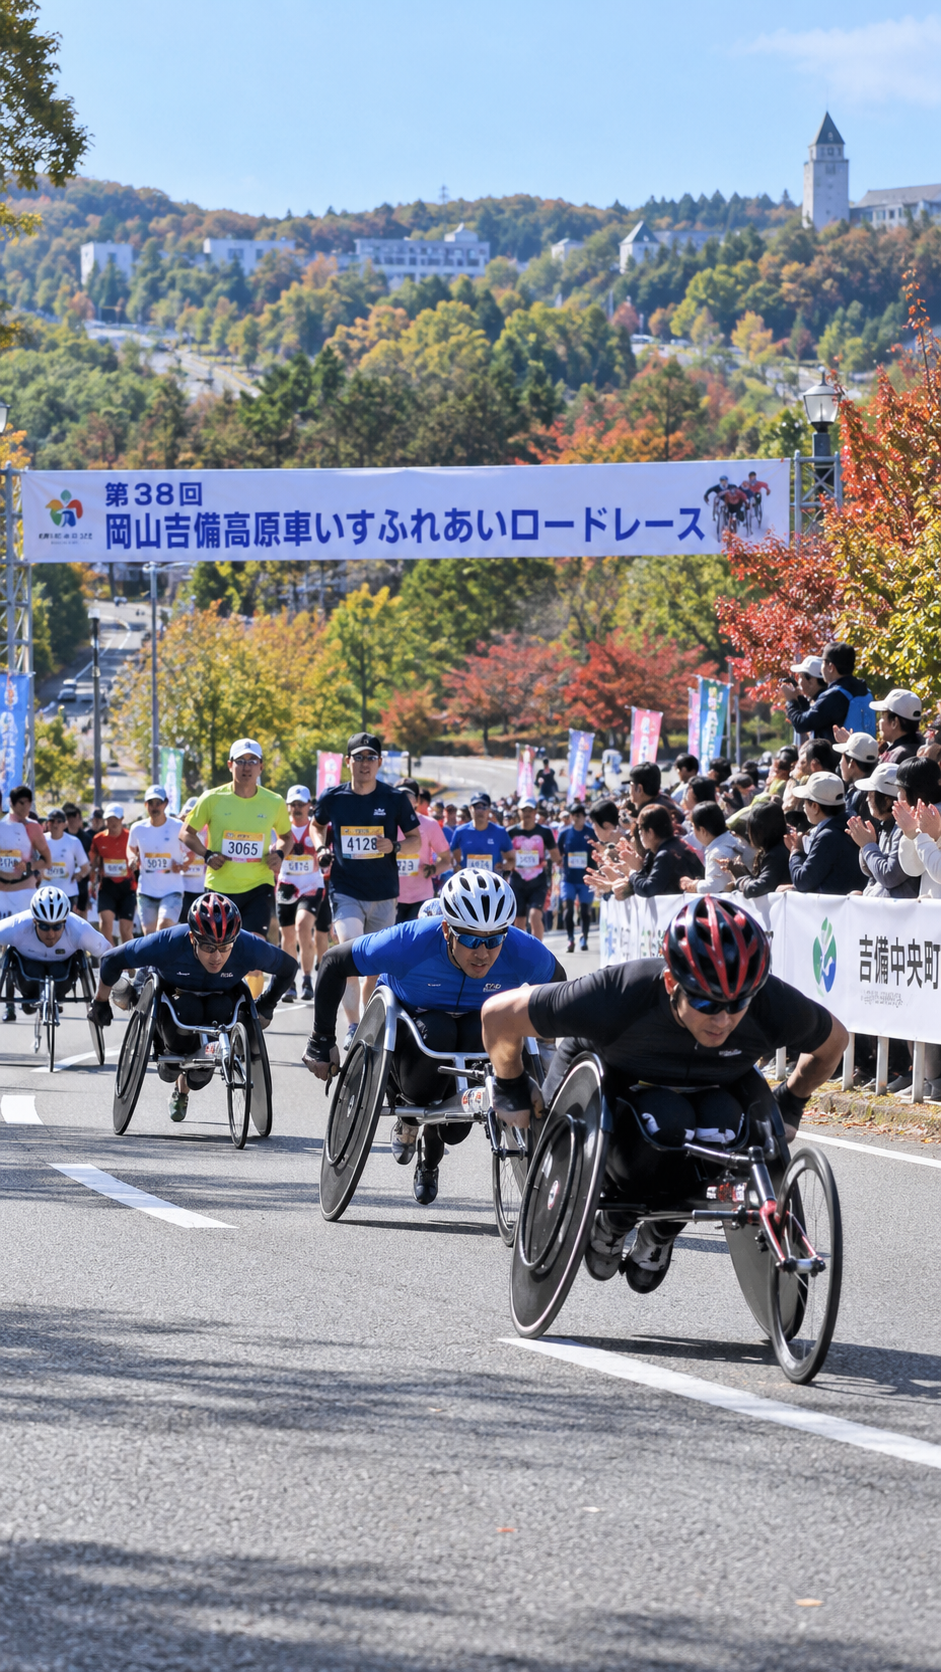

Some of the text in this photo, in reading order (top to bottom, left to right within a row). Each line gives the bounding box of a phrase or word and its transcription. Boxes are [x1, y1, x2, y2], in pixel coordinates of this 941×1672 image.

[105, 482, 203, 507] 第38回
[105, 507, 705, 550] 岡山吉備高原車いすふれあいロードレース
[228, 841, 258, 856] 3065
[347, 837, 378, 851] 4128
[859, 934, 941, 990] 吉備中央町
